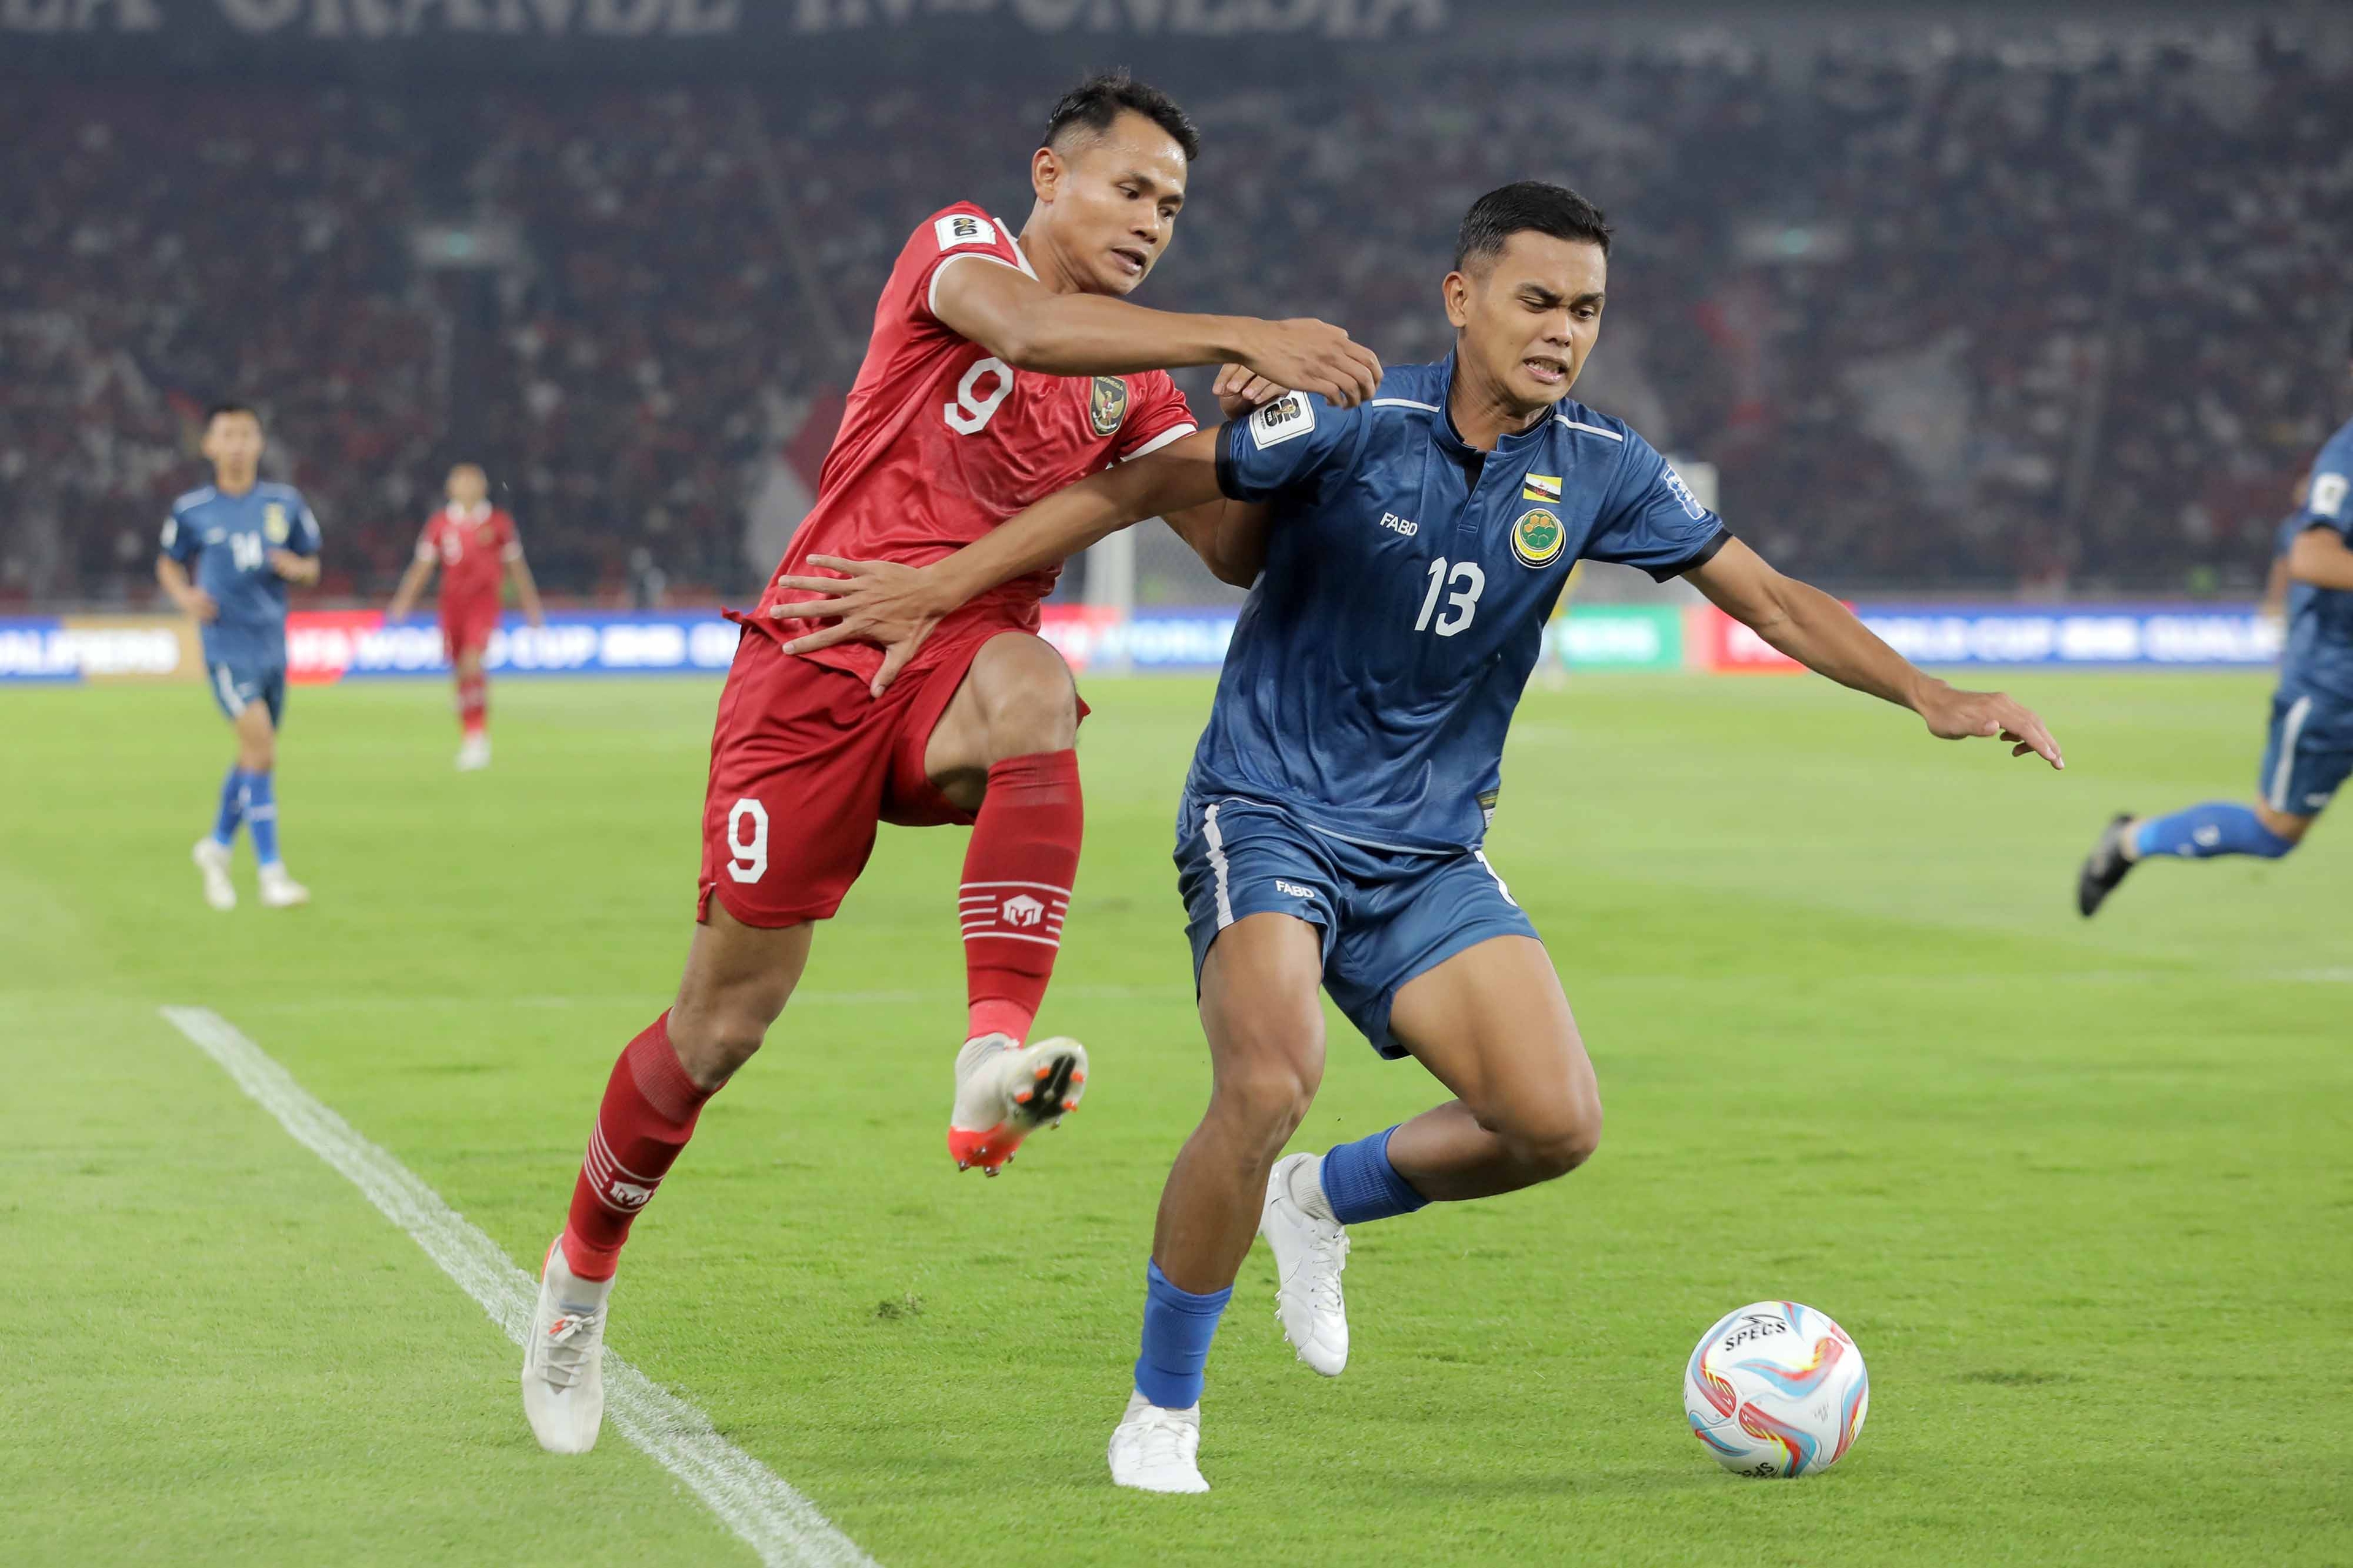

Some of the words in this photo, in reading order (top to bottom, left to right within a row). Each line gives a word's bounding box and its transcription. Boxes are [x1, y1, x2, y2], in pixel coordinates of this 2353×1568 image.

[944, 357, 1014, 436] 9
[1379, 512, 1418, 536] FABD
[1414, 556, 1485, 637] 13
[727, 798, 768, 884] 9
[1275, 880, 1315, 898] FABD
[1725, 1320, 1787, 1351] SPECS
